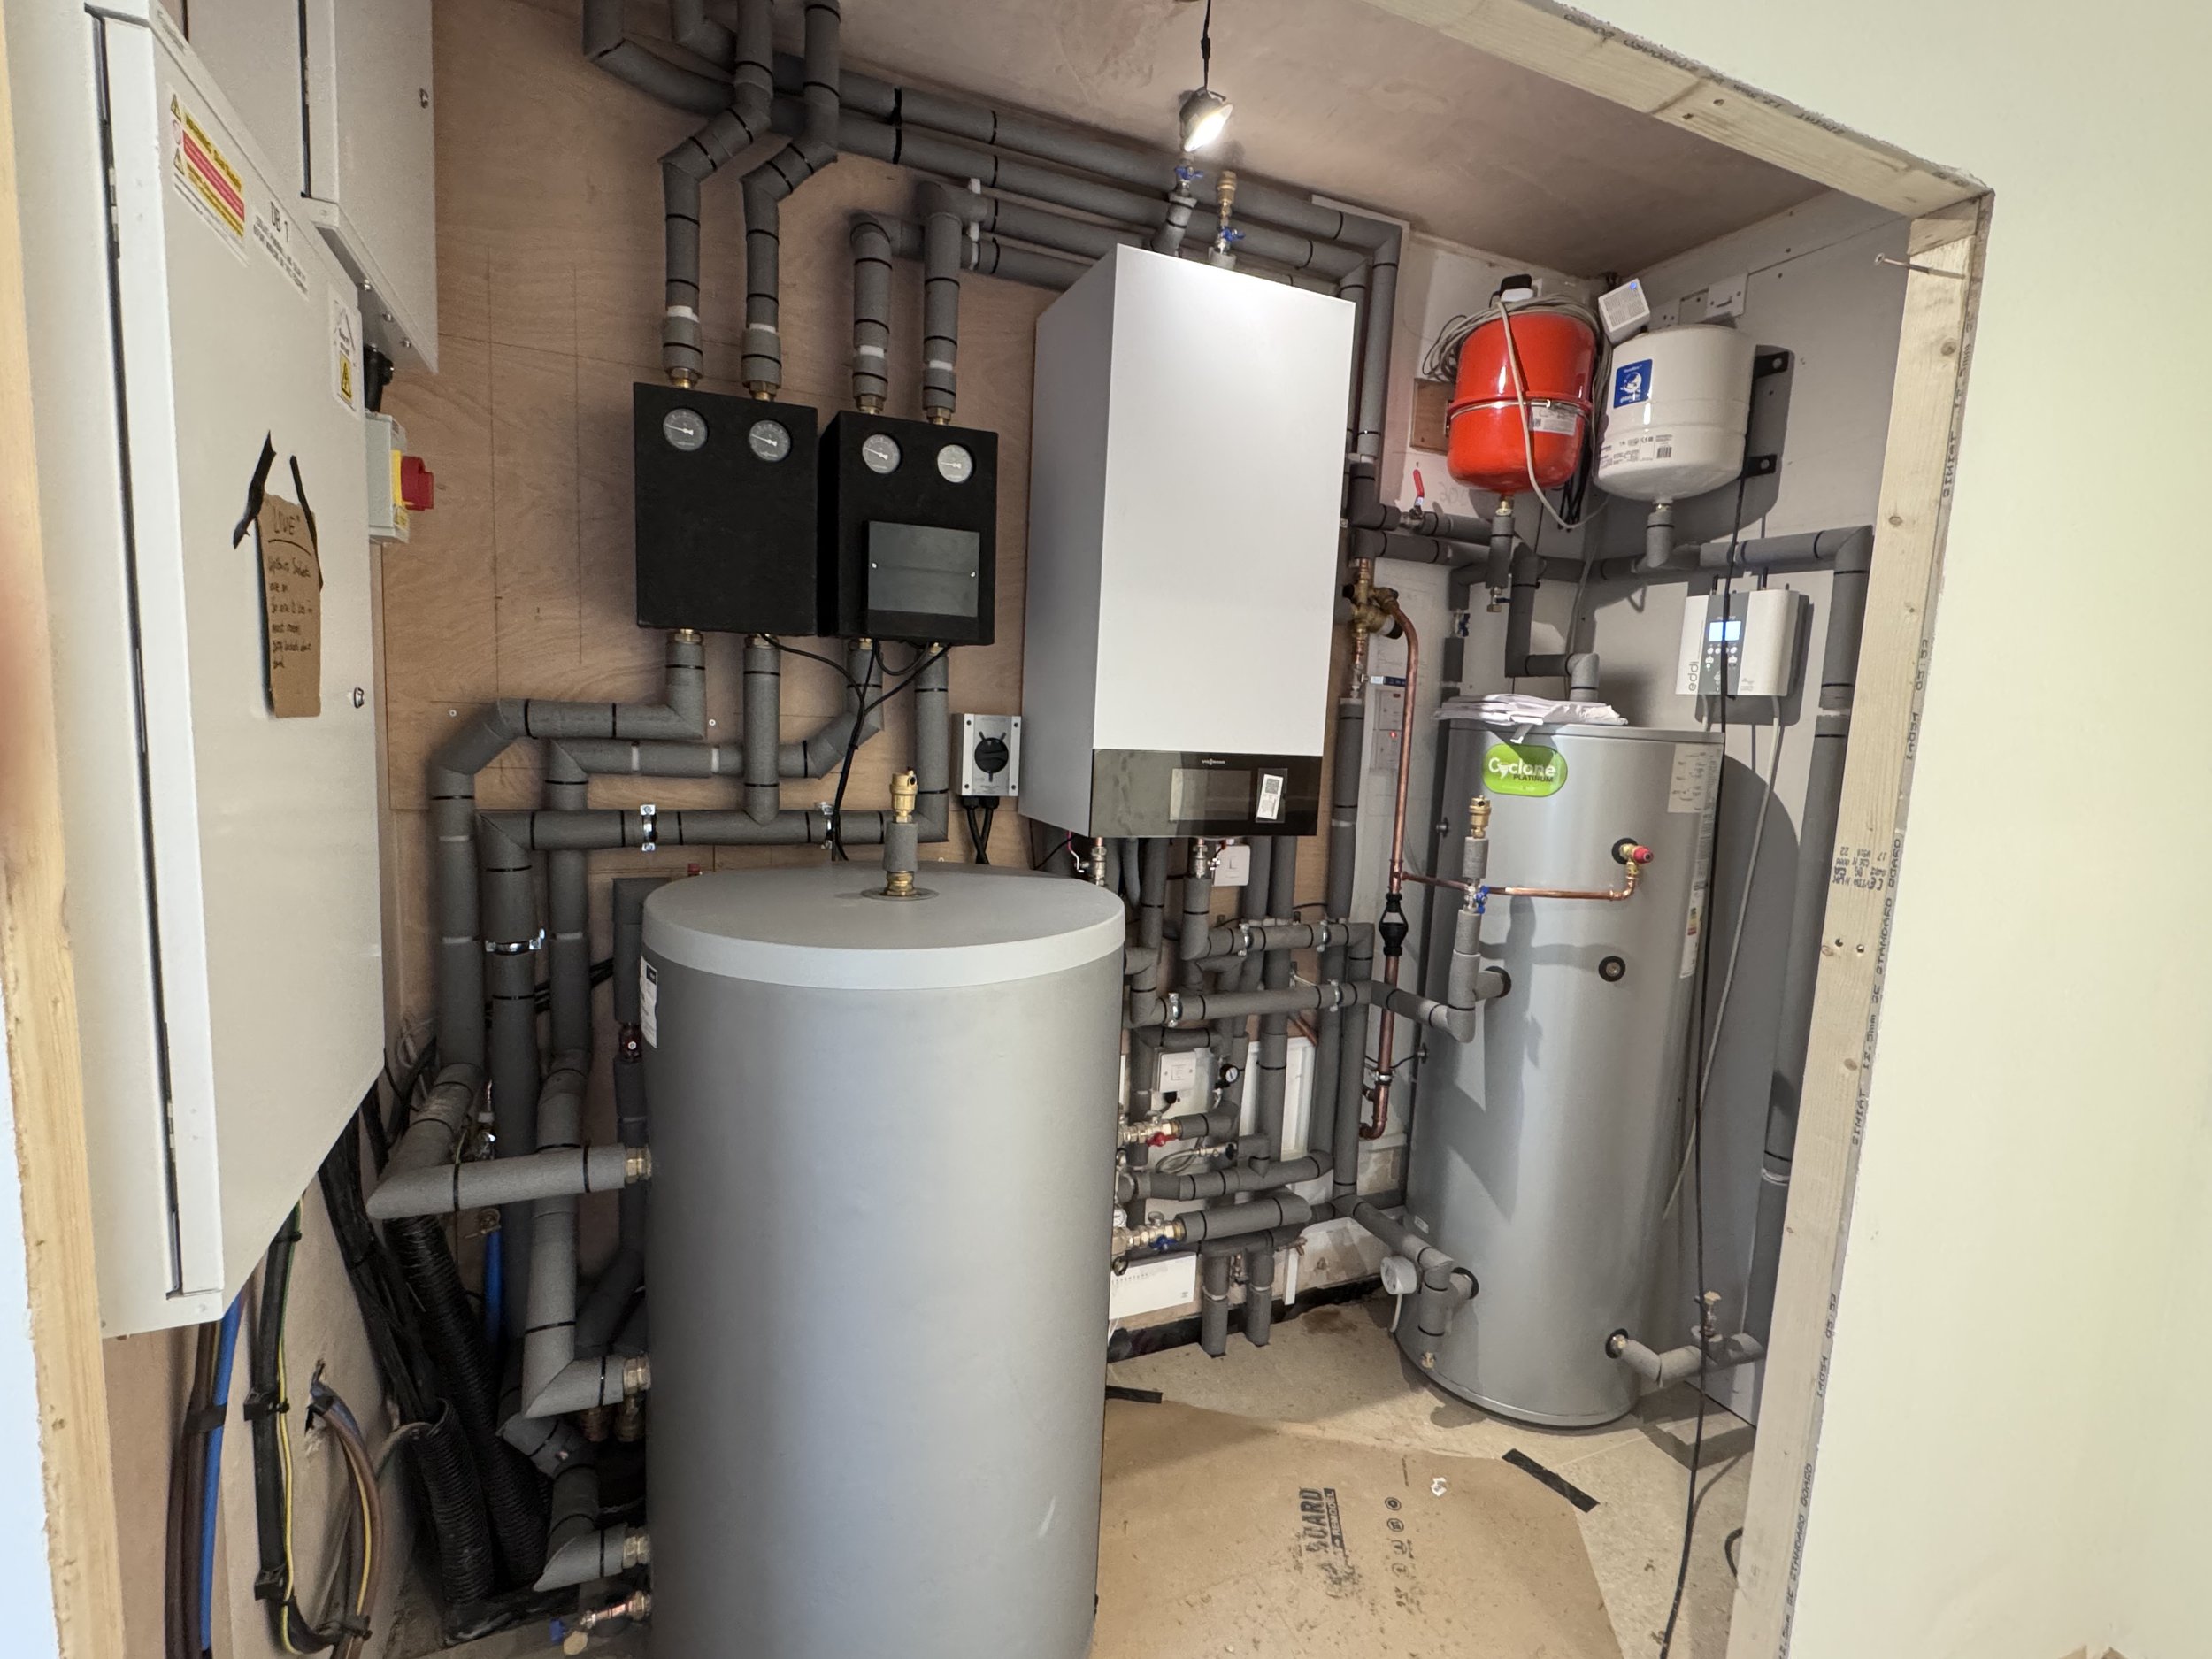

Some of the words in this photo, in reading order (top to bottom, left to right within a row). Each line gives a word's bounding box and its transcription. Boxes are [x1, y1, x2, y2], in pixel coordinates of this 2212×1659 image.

[270, 201, 281, 232] DB
[1688, 661, 1699, 691] eddi
[1488, 757, 1556, 780] Cyclone
[1512, 773, 1555, 784] PLATINUM
[1876, 897, 1893, 975] STANDARD
[1887, 838, 1901, 888] BOARD
[1790, 1514, 1807, 1581] STANDARD
